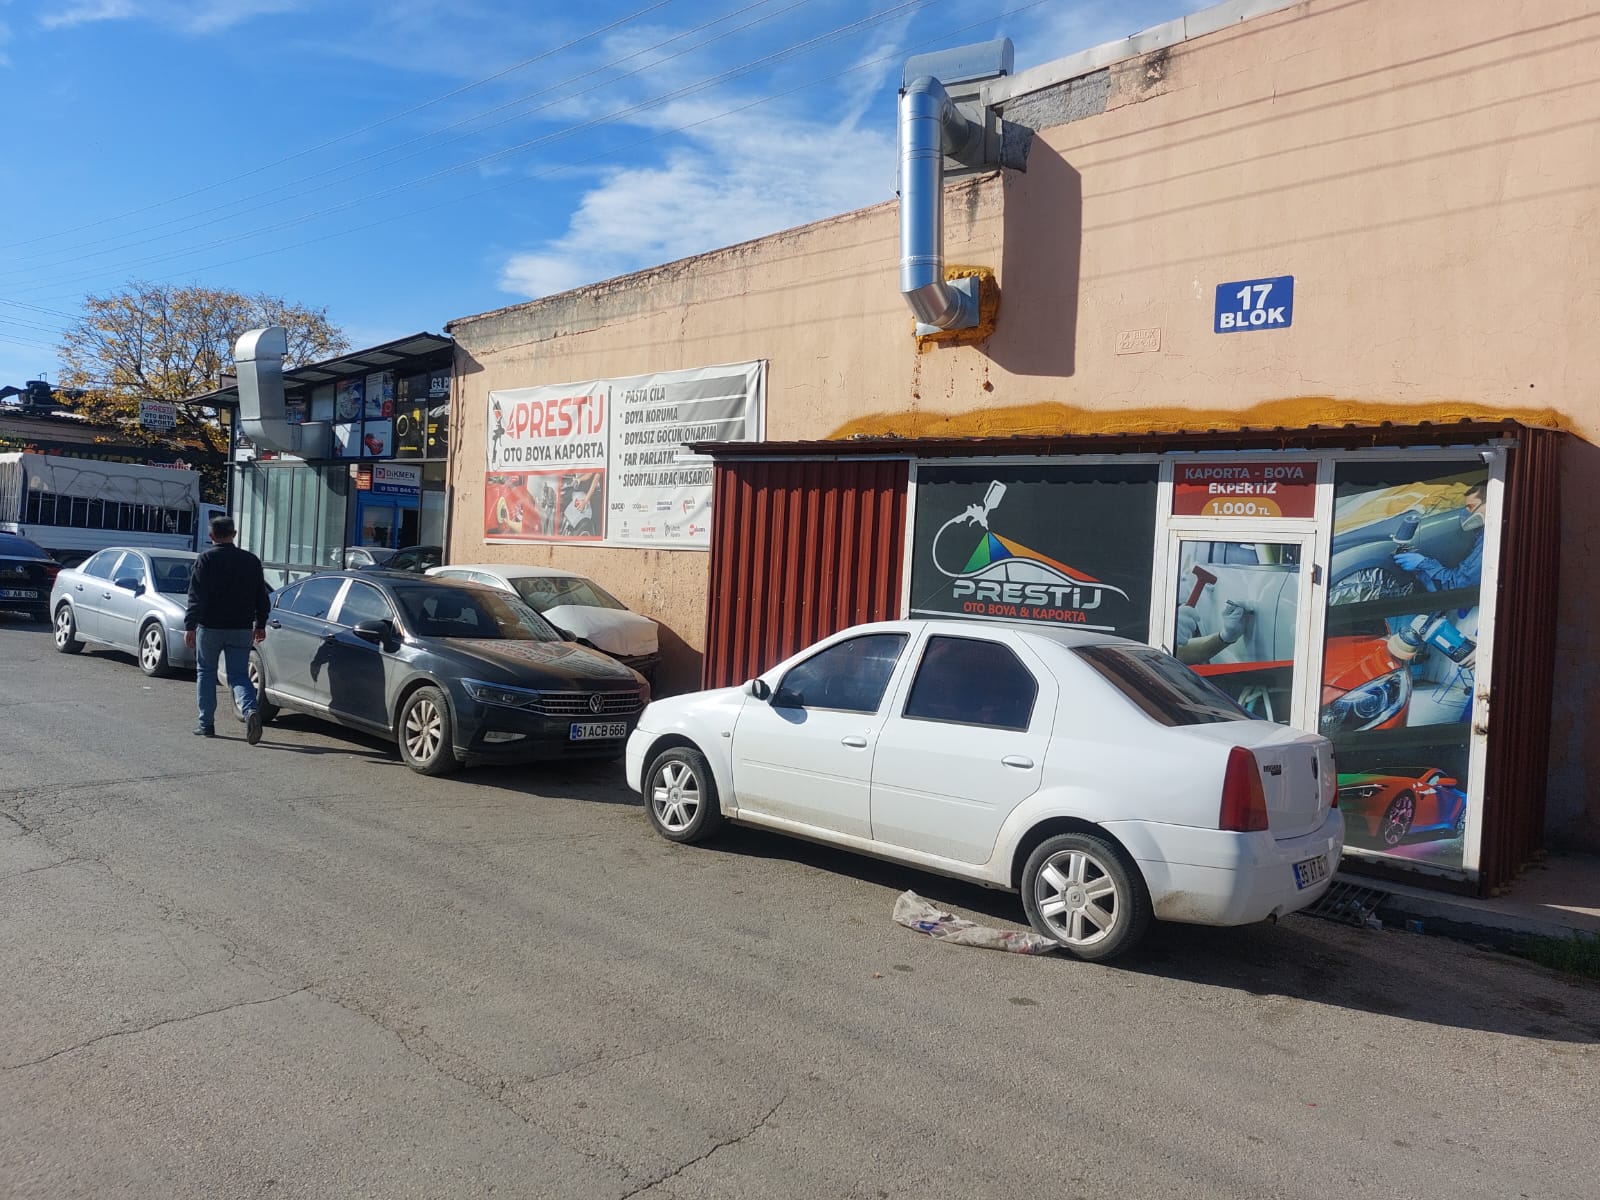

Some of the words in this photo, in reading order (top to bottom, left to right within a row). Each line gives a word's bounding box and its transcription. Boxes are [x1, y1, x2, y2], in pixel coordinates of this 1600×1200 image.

[1236, 284, 1272, 310] 17
[1220, 307, 1285, 328] BLOK
[625, 389, 648, 404] PASTA
[650, 384, 665, 400] CİLA
[625, 411, 644, 424] BOYA
[645, 407, 678, 423] KORUMA
[624, 431, 654, 445] BOYASIZ
[657, 425, 682, 446] GÖÇÜK
[684, 426, 717, 441] ONARIM
[503, 447, 522, 462] OTO
[525, 446, 552, 461] BOYA
[554, 442, 604, 460] KAPORTA
[623, 452, 638, 466] FAR
[623, 470, 657, 487] SİGORTALI
[659, 471, 677, 489] ARAÇ
[679, 470, 702, 485] HASAR
[1185, 467, 1250, 479] KAPORTA
[1264, 466, 1304, 479] BOYA
[1208, 480, 1277, 494] EKPERTİZ
[1212, 502, 1256, 515] 1.000
[1258, 507, 1270, 515] TL
[963, 601, 985, 613] OTO
[988, 604, 1017, 616] BOYA
[1019, 607, 1030, 618] &
[1032, 608, 1086, 623] KAPORTA
[576, 725, 587, 737] 61
[589, 725, 608, 736] ACB
[609, 724, 625, 736] 666
